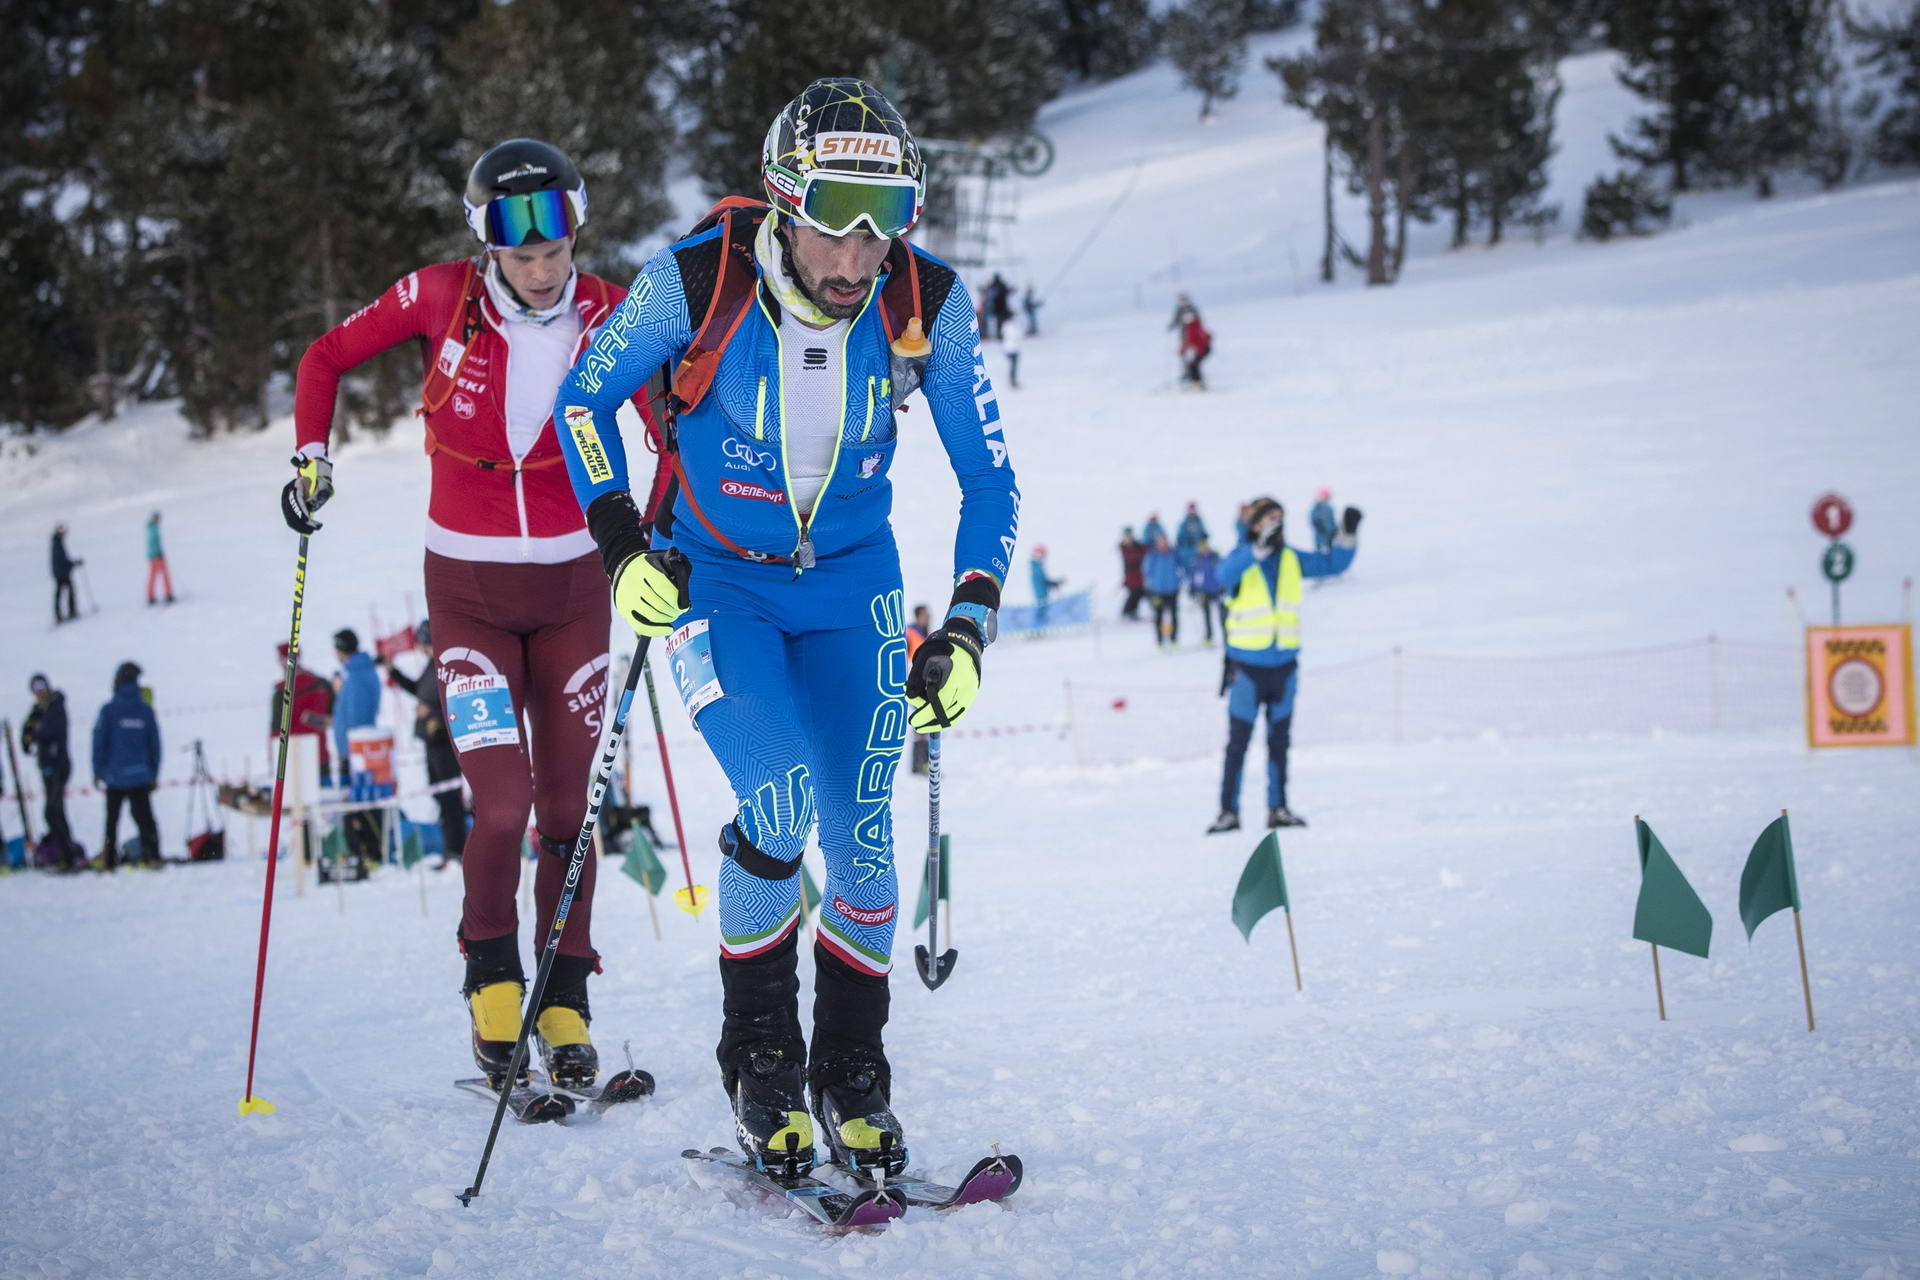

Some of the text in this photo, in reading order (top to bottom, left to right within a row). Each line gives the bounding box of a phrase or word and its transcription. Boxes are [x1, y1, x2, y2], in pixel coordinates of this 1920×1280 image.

[820, 137, 896, 158] STIHL
[456, 377, 487, 394] EKI
[454, 396, 474, 417] Buff
[575, 429, 601, 479] SPECIALIST
[589, 442, 609, 477] SPORT
[724, 461, 751, 472] Audi
[675, 659, 689, 690] 2
[471, 698, 489, 721] 3
[467, 719, 498, 731] WERNER
[850, 904, 894, 922] ENERVIT
